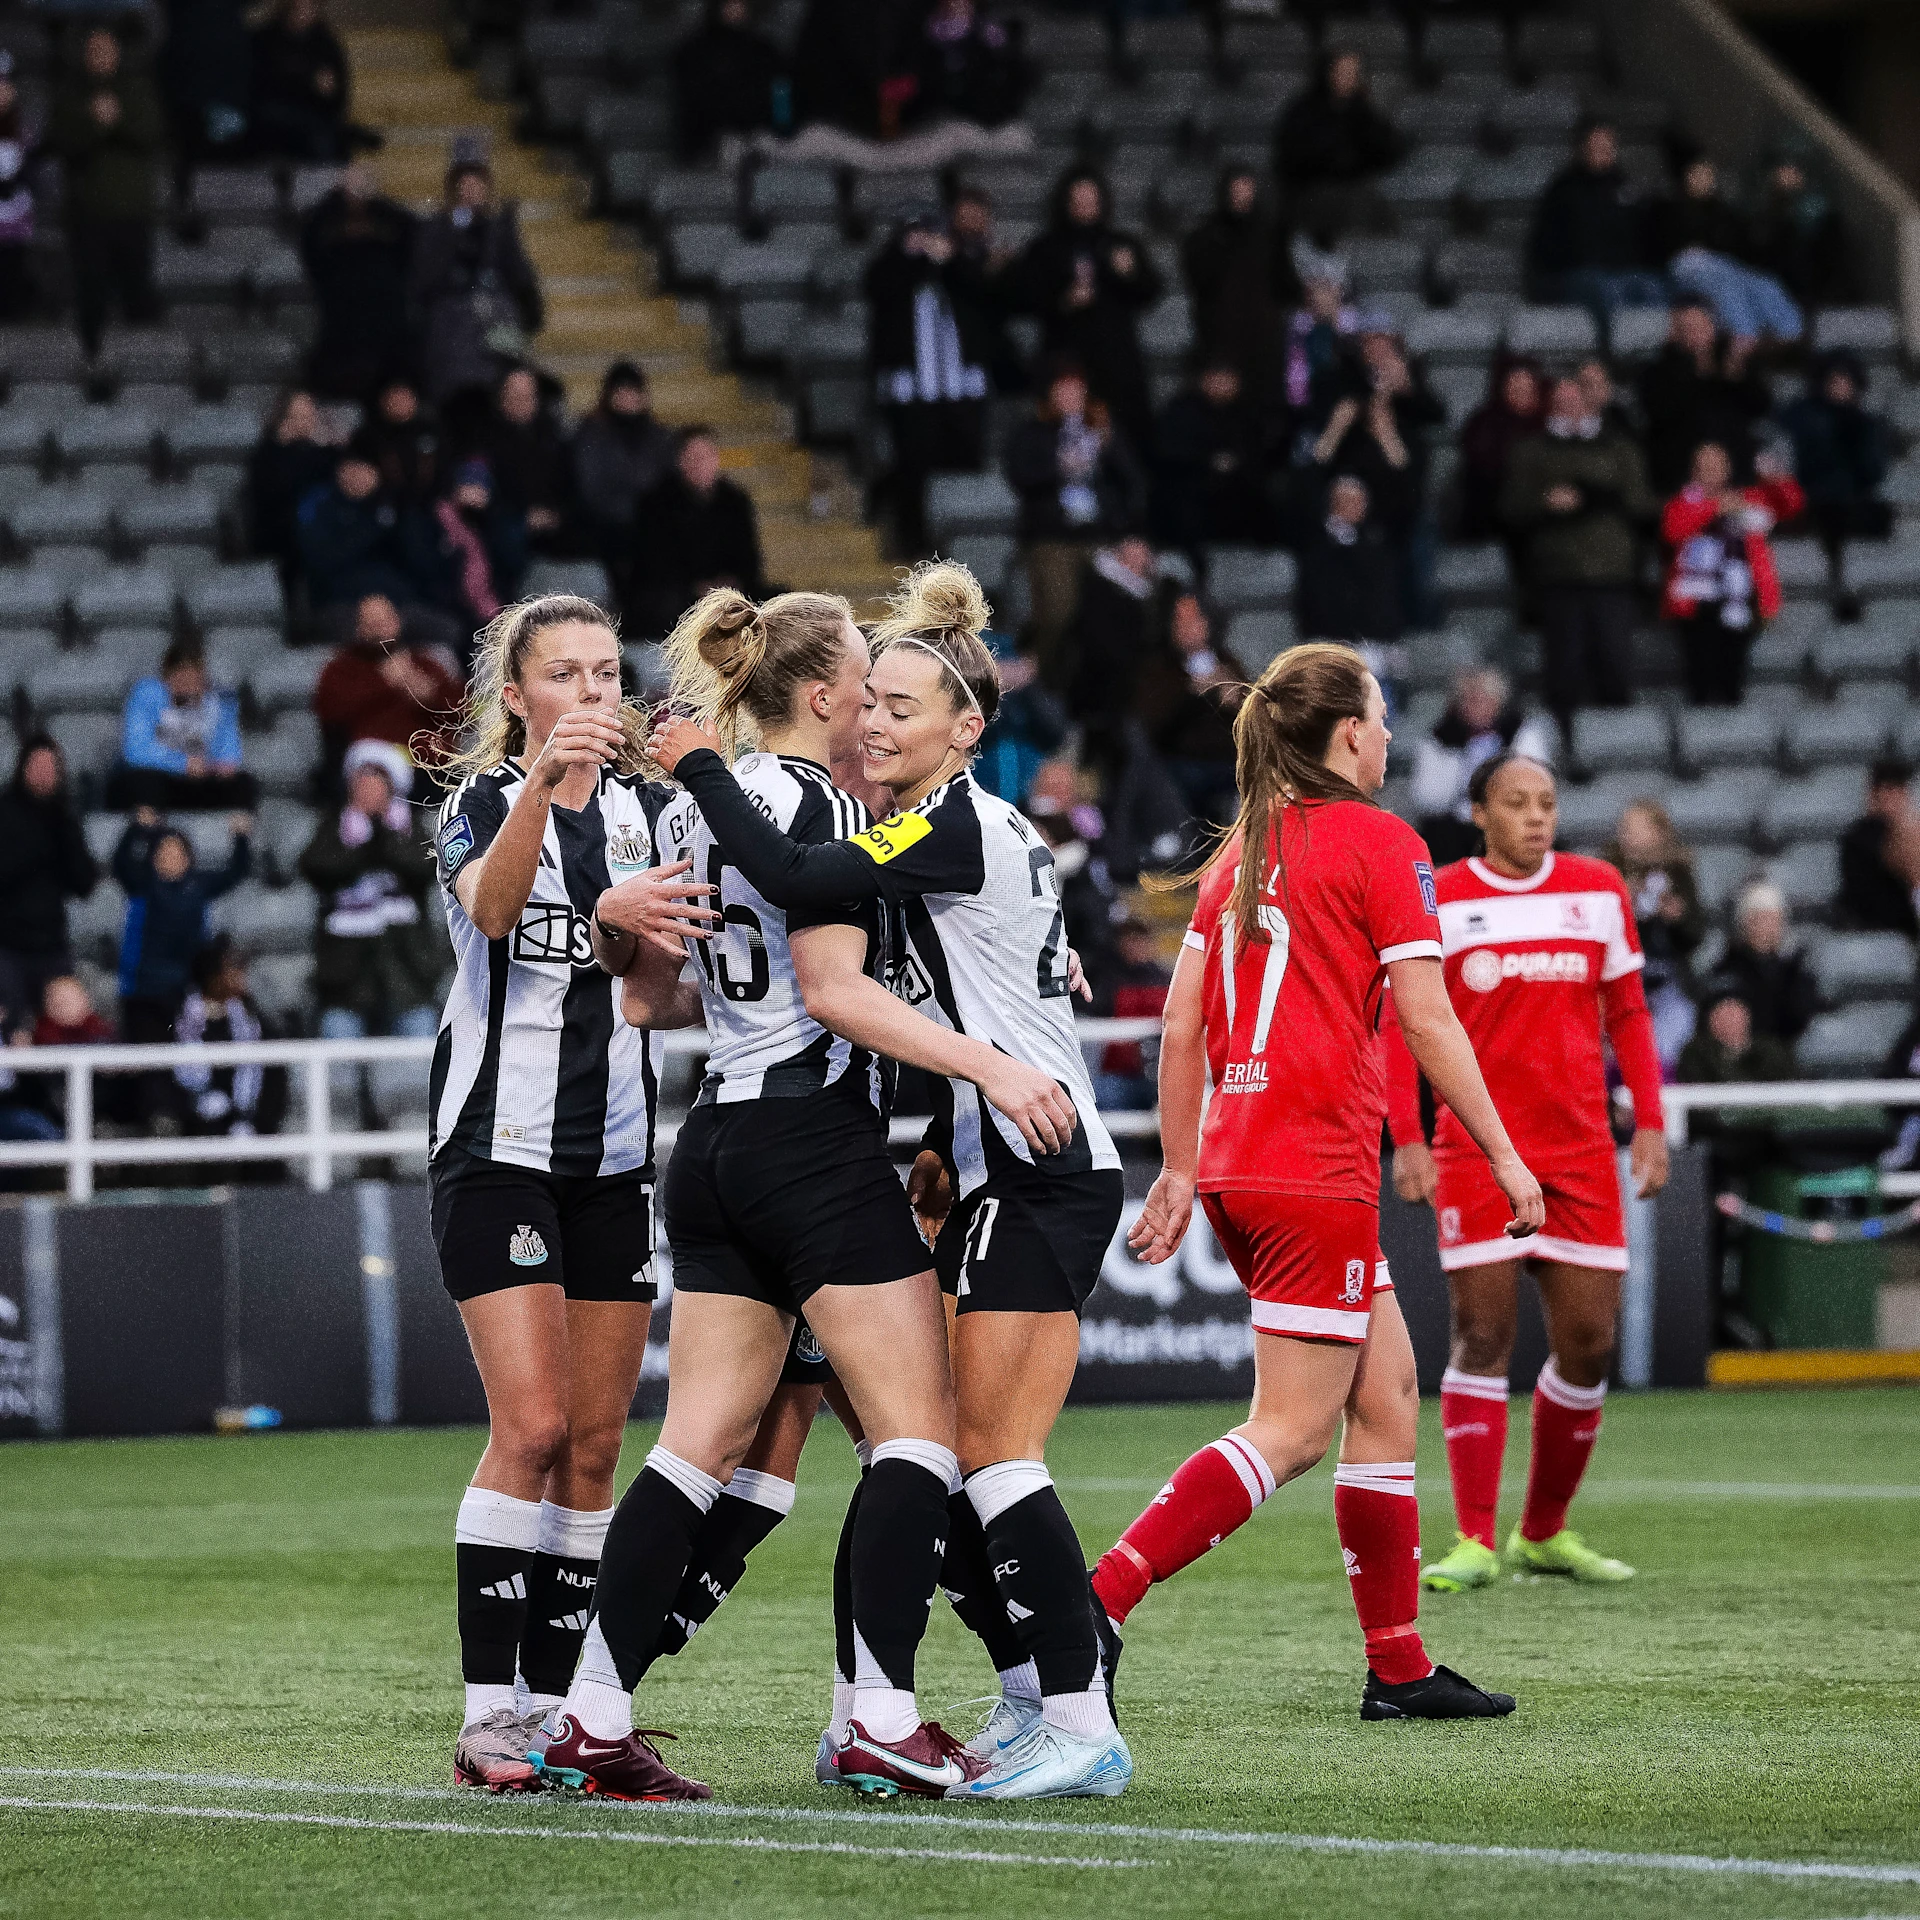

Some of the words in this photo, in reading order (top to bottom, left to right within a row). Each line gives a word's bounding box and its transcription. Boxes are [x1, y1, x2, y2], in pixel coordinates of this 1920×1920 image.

[1028, 845, 1070, 999] 2
[641, 1184, 656, 1251] 1
[557, 1567, 597, 1589] NUF
[993, 1559, 1020, 1583] FC
[699, 1572, 728, 1603] NU
